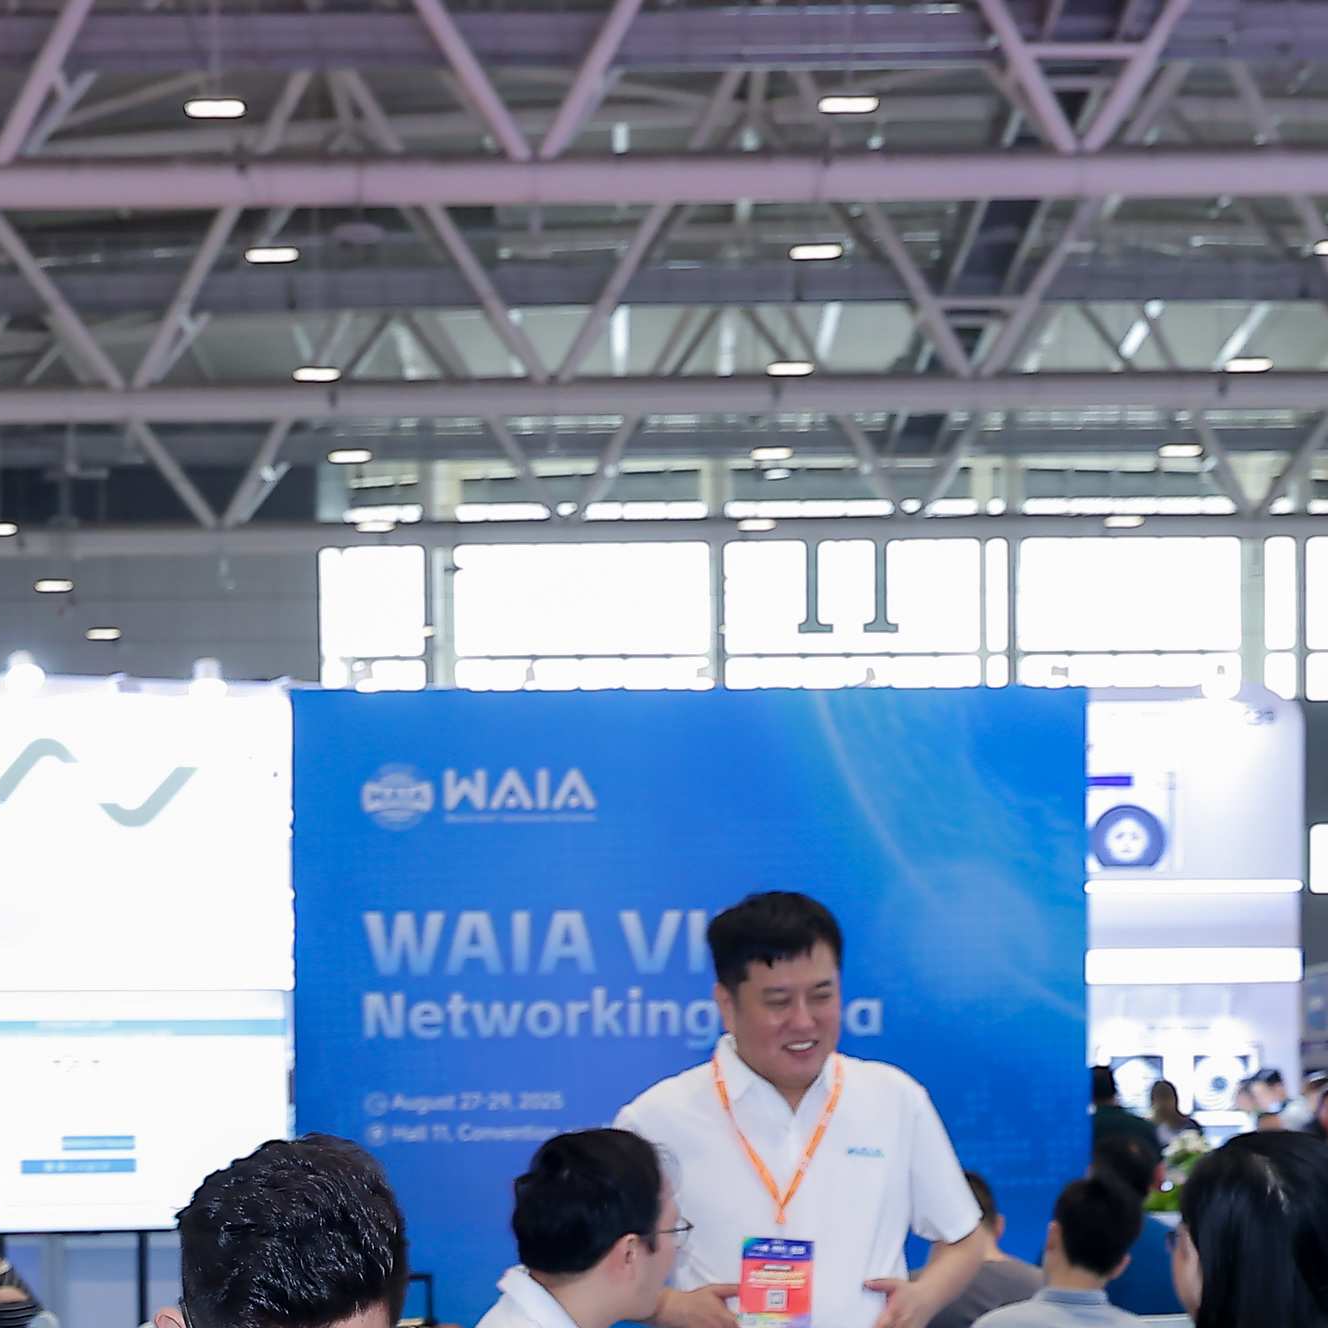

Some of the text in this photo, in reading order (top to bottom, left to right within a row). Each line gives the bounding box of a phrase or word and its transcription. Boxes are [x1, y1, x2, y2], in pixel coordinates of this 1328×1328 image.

[443, 768, 598, 811] WAIA
[364, 909, 714, 976] WAIA VI
[363, 987, 719, 1048] Networking
[392, 1093, 454, 1114] August
